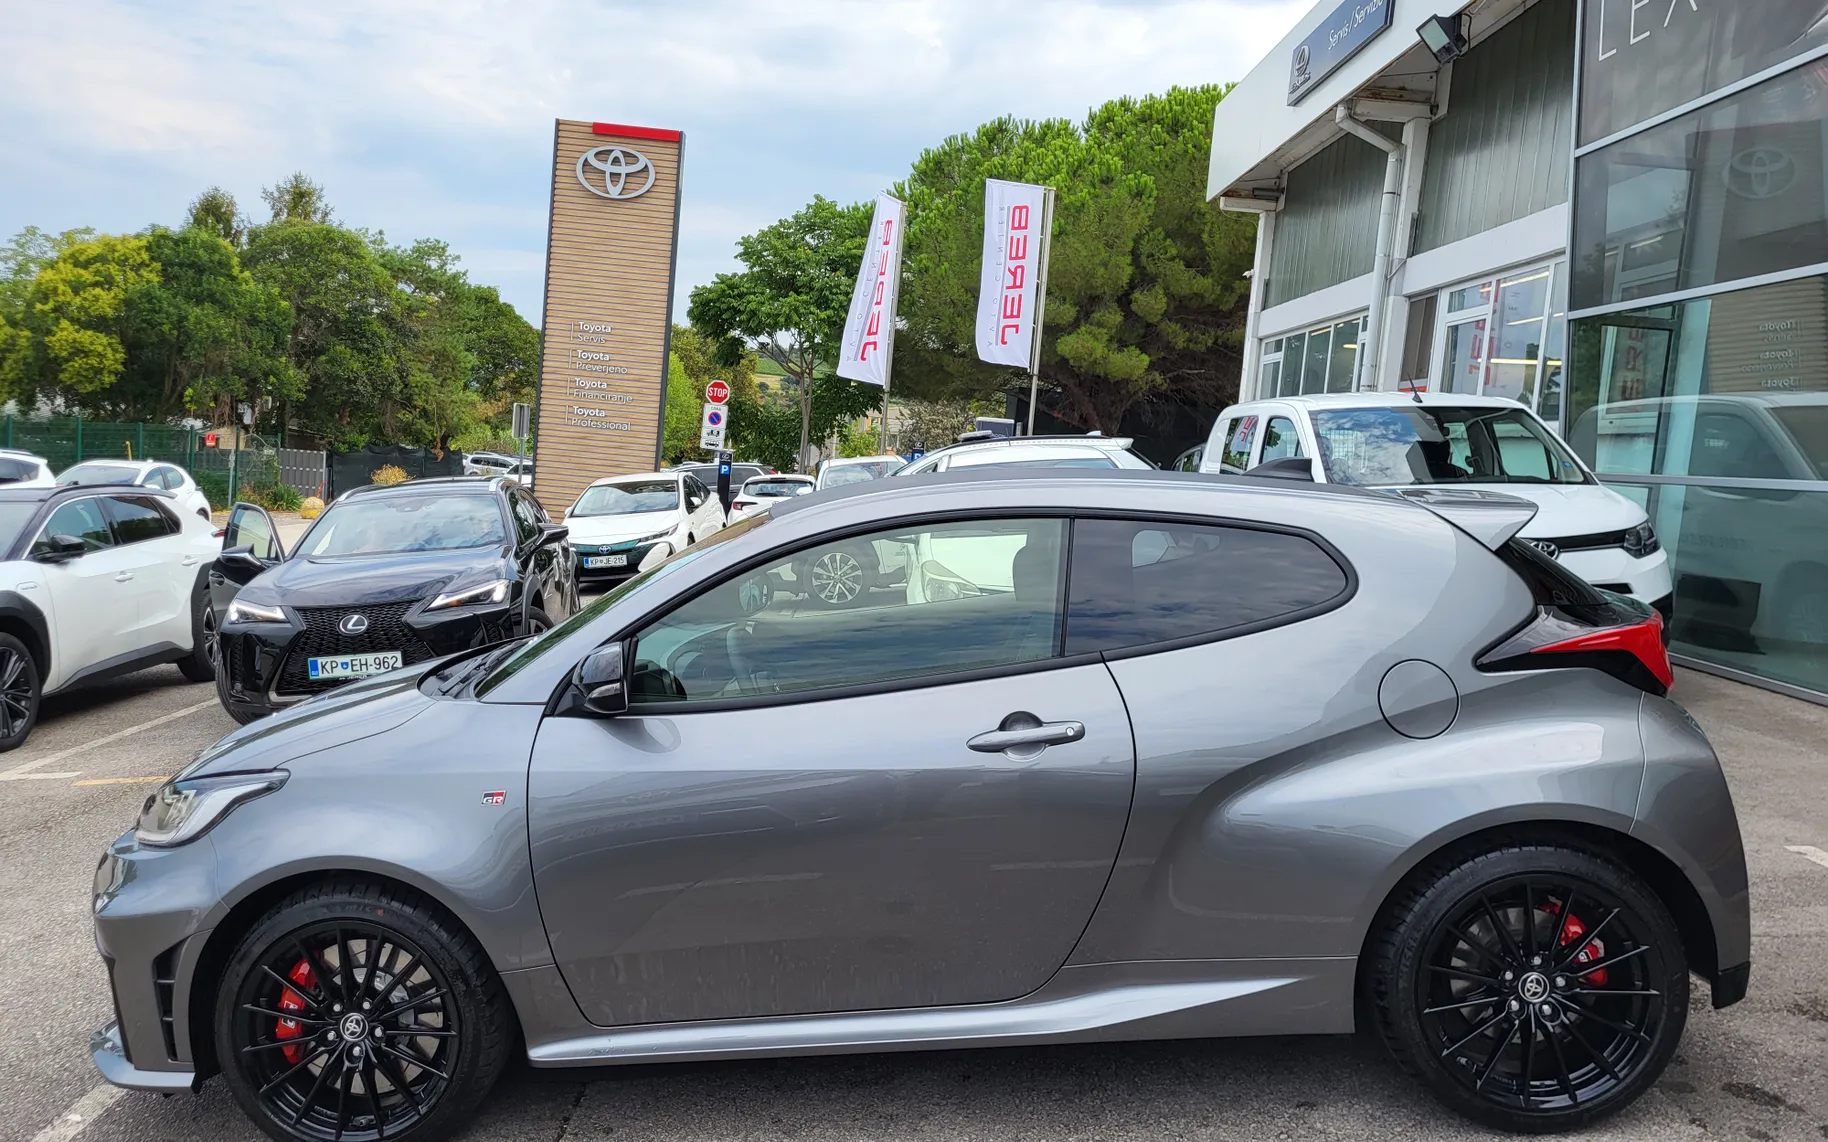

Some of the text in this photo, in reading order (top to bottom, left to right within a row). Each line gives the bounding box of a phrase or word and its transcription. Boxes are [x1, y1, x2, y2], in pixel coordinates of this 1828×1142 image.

[578, 321, 612, 333] Toyota
[577, 333, 606, 344] Servis
[576, 349, 610, 361] Toyota
[576, 362, 628, 375] Preverjeno
[574, 377, 608, 389] Toyota
[573, 389, 633, 404] Financiranje
[708, 387, 728, 398] STOP
[572, 405, 606, 417] Toyota
[571, 417, 632, 431] Professional
[721, 465, 729, 474] P
[320, 655, 399, 675] KP EH-962
[483, 796, 504, 805] GR
